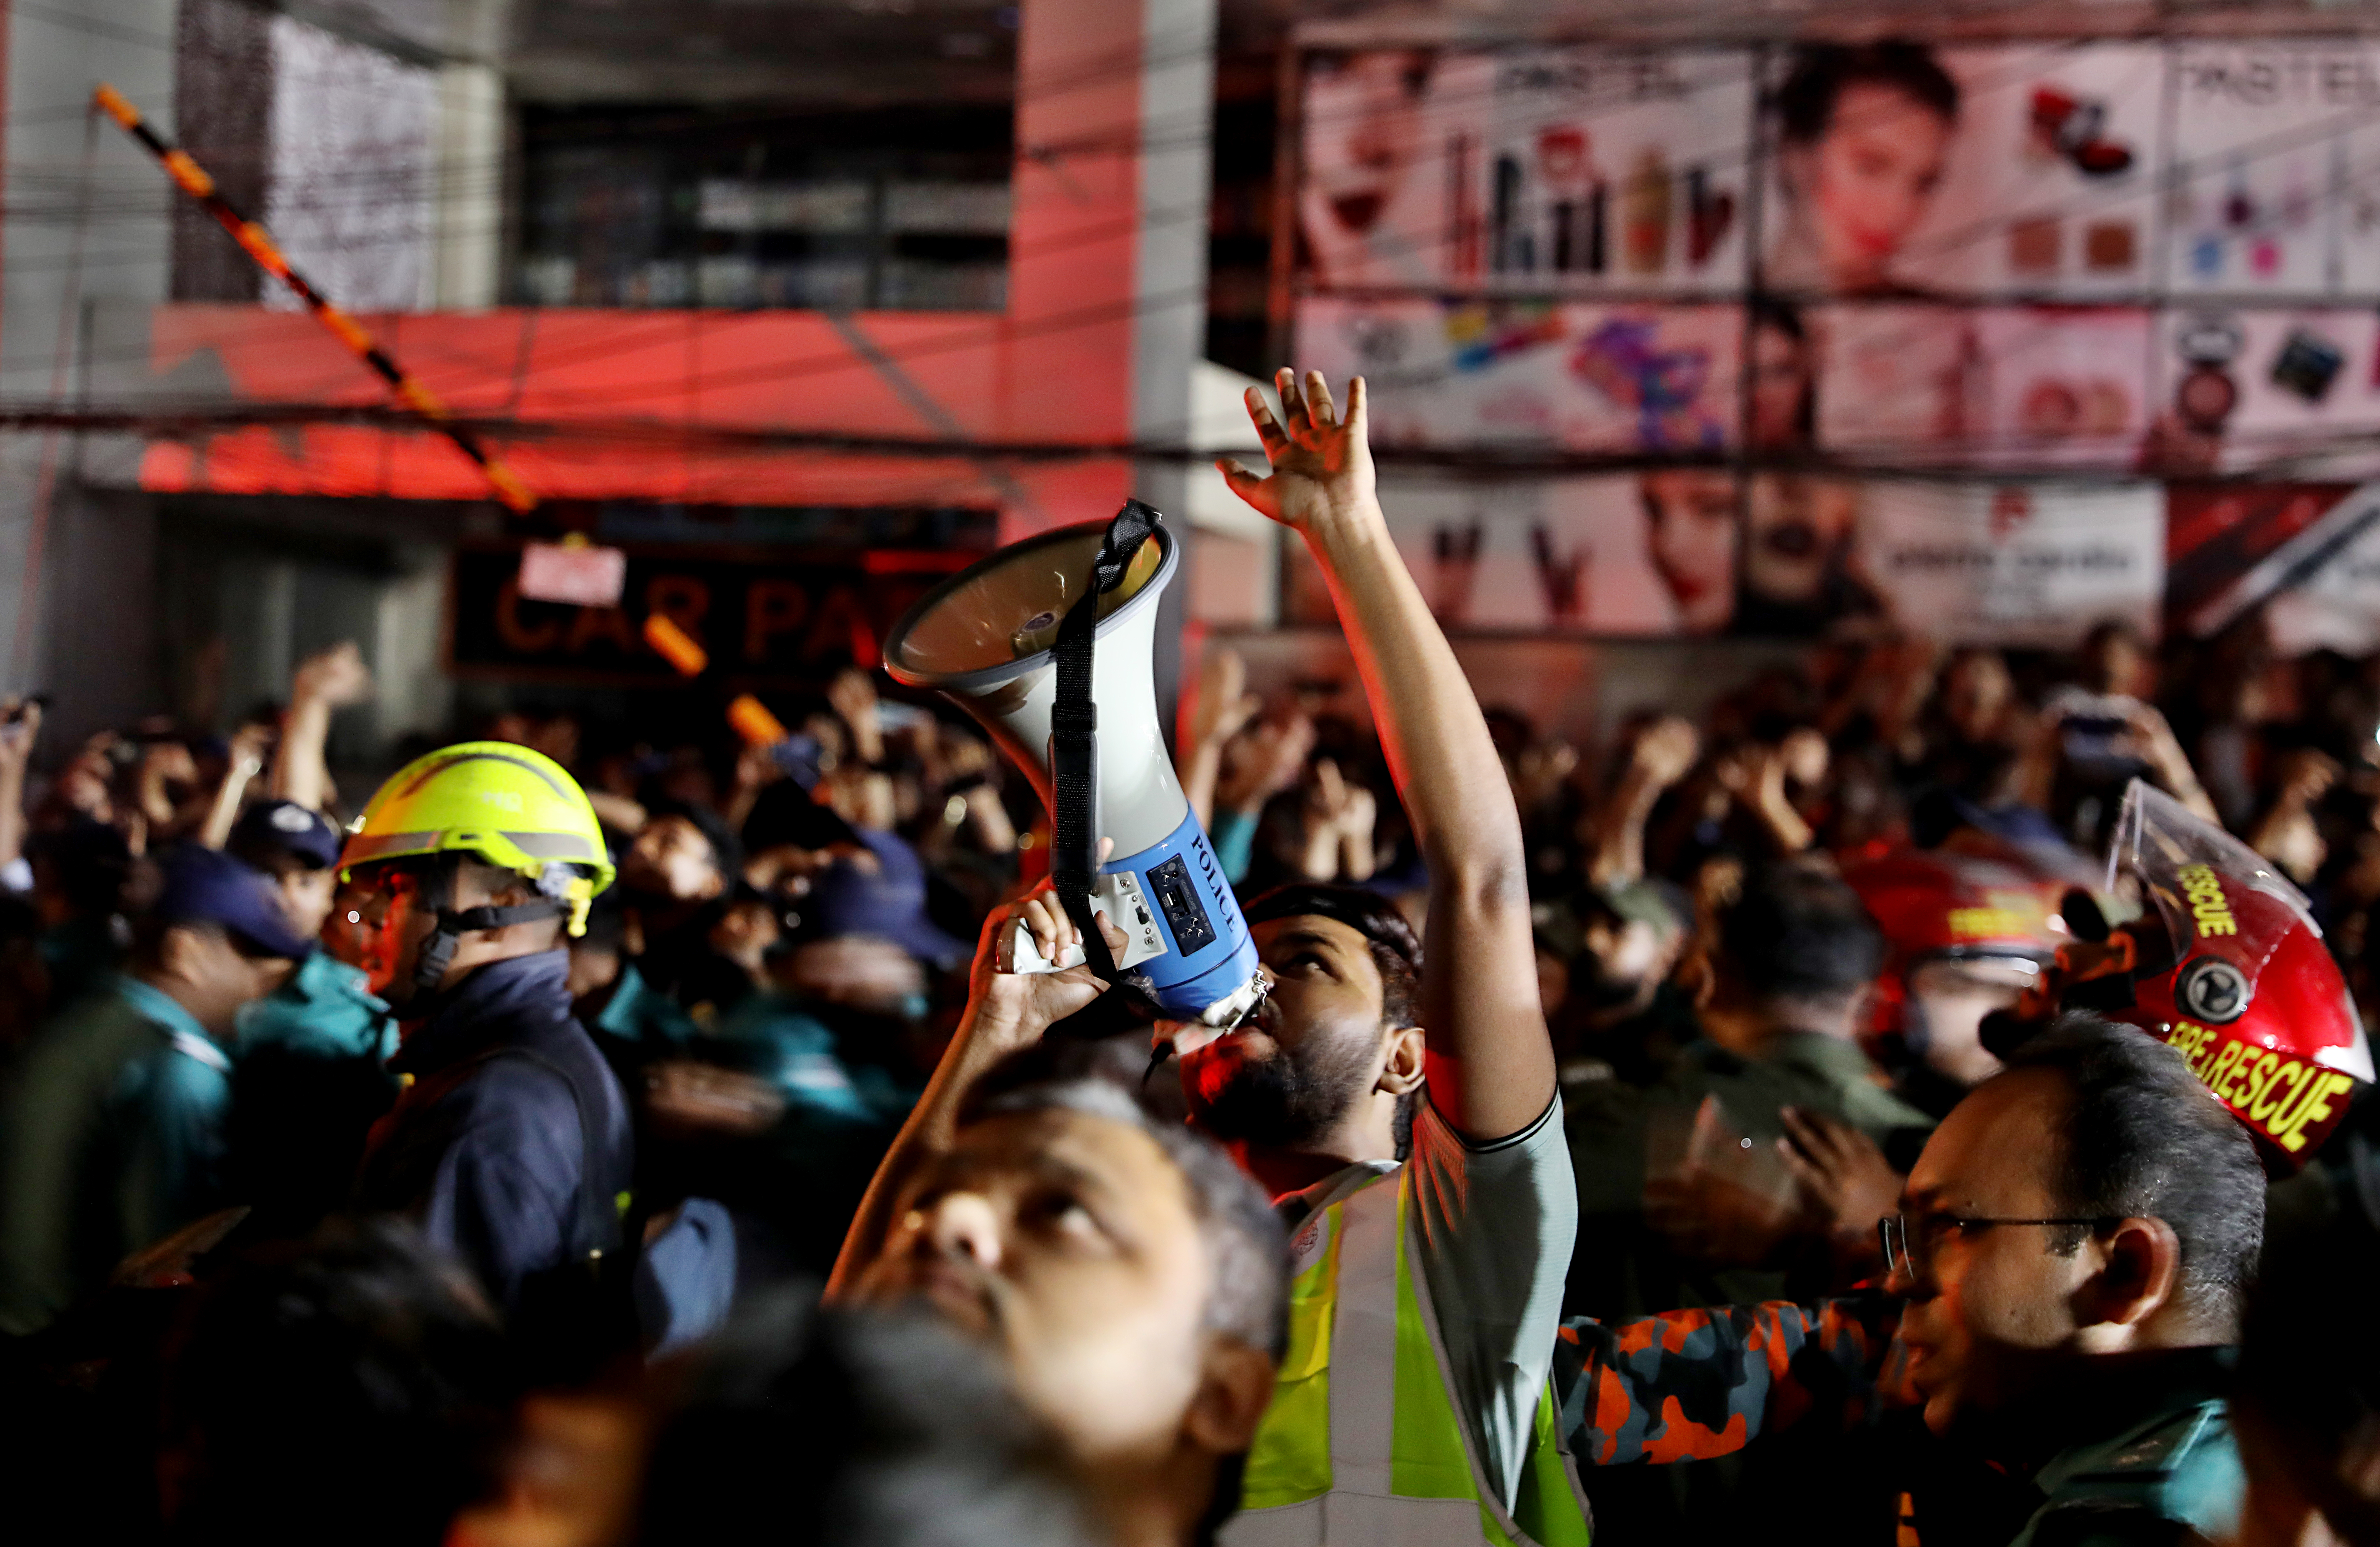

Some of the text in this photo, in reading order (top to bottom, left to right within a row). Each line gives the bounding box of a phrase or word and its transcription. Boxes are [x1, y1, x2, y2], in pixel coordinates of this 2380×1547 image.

[1188, 897, 1197, 910] CARD
[1190, 833, 1237, 933] POLICE
[2178, 864, 2237, 938] RESCUE
[2201, 1039, 2354, 1152] RESCUE
